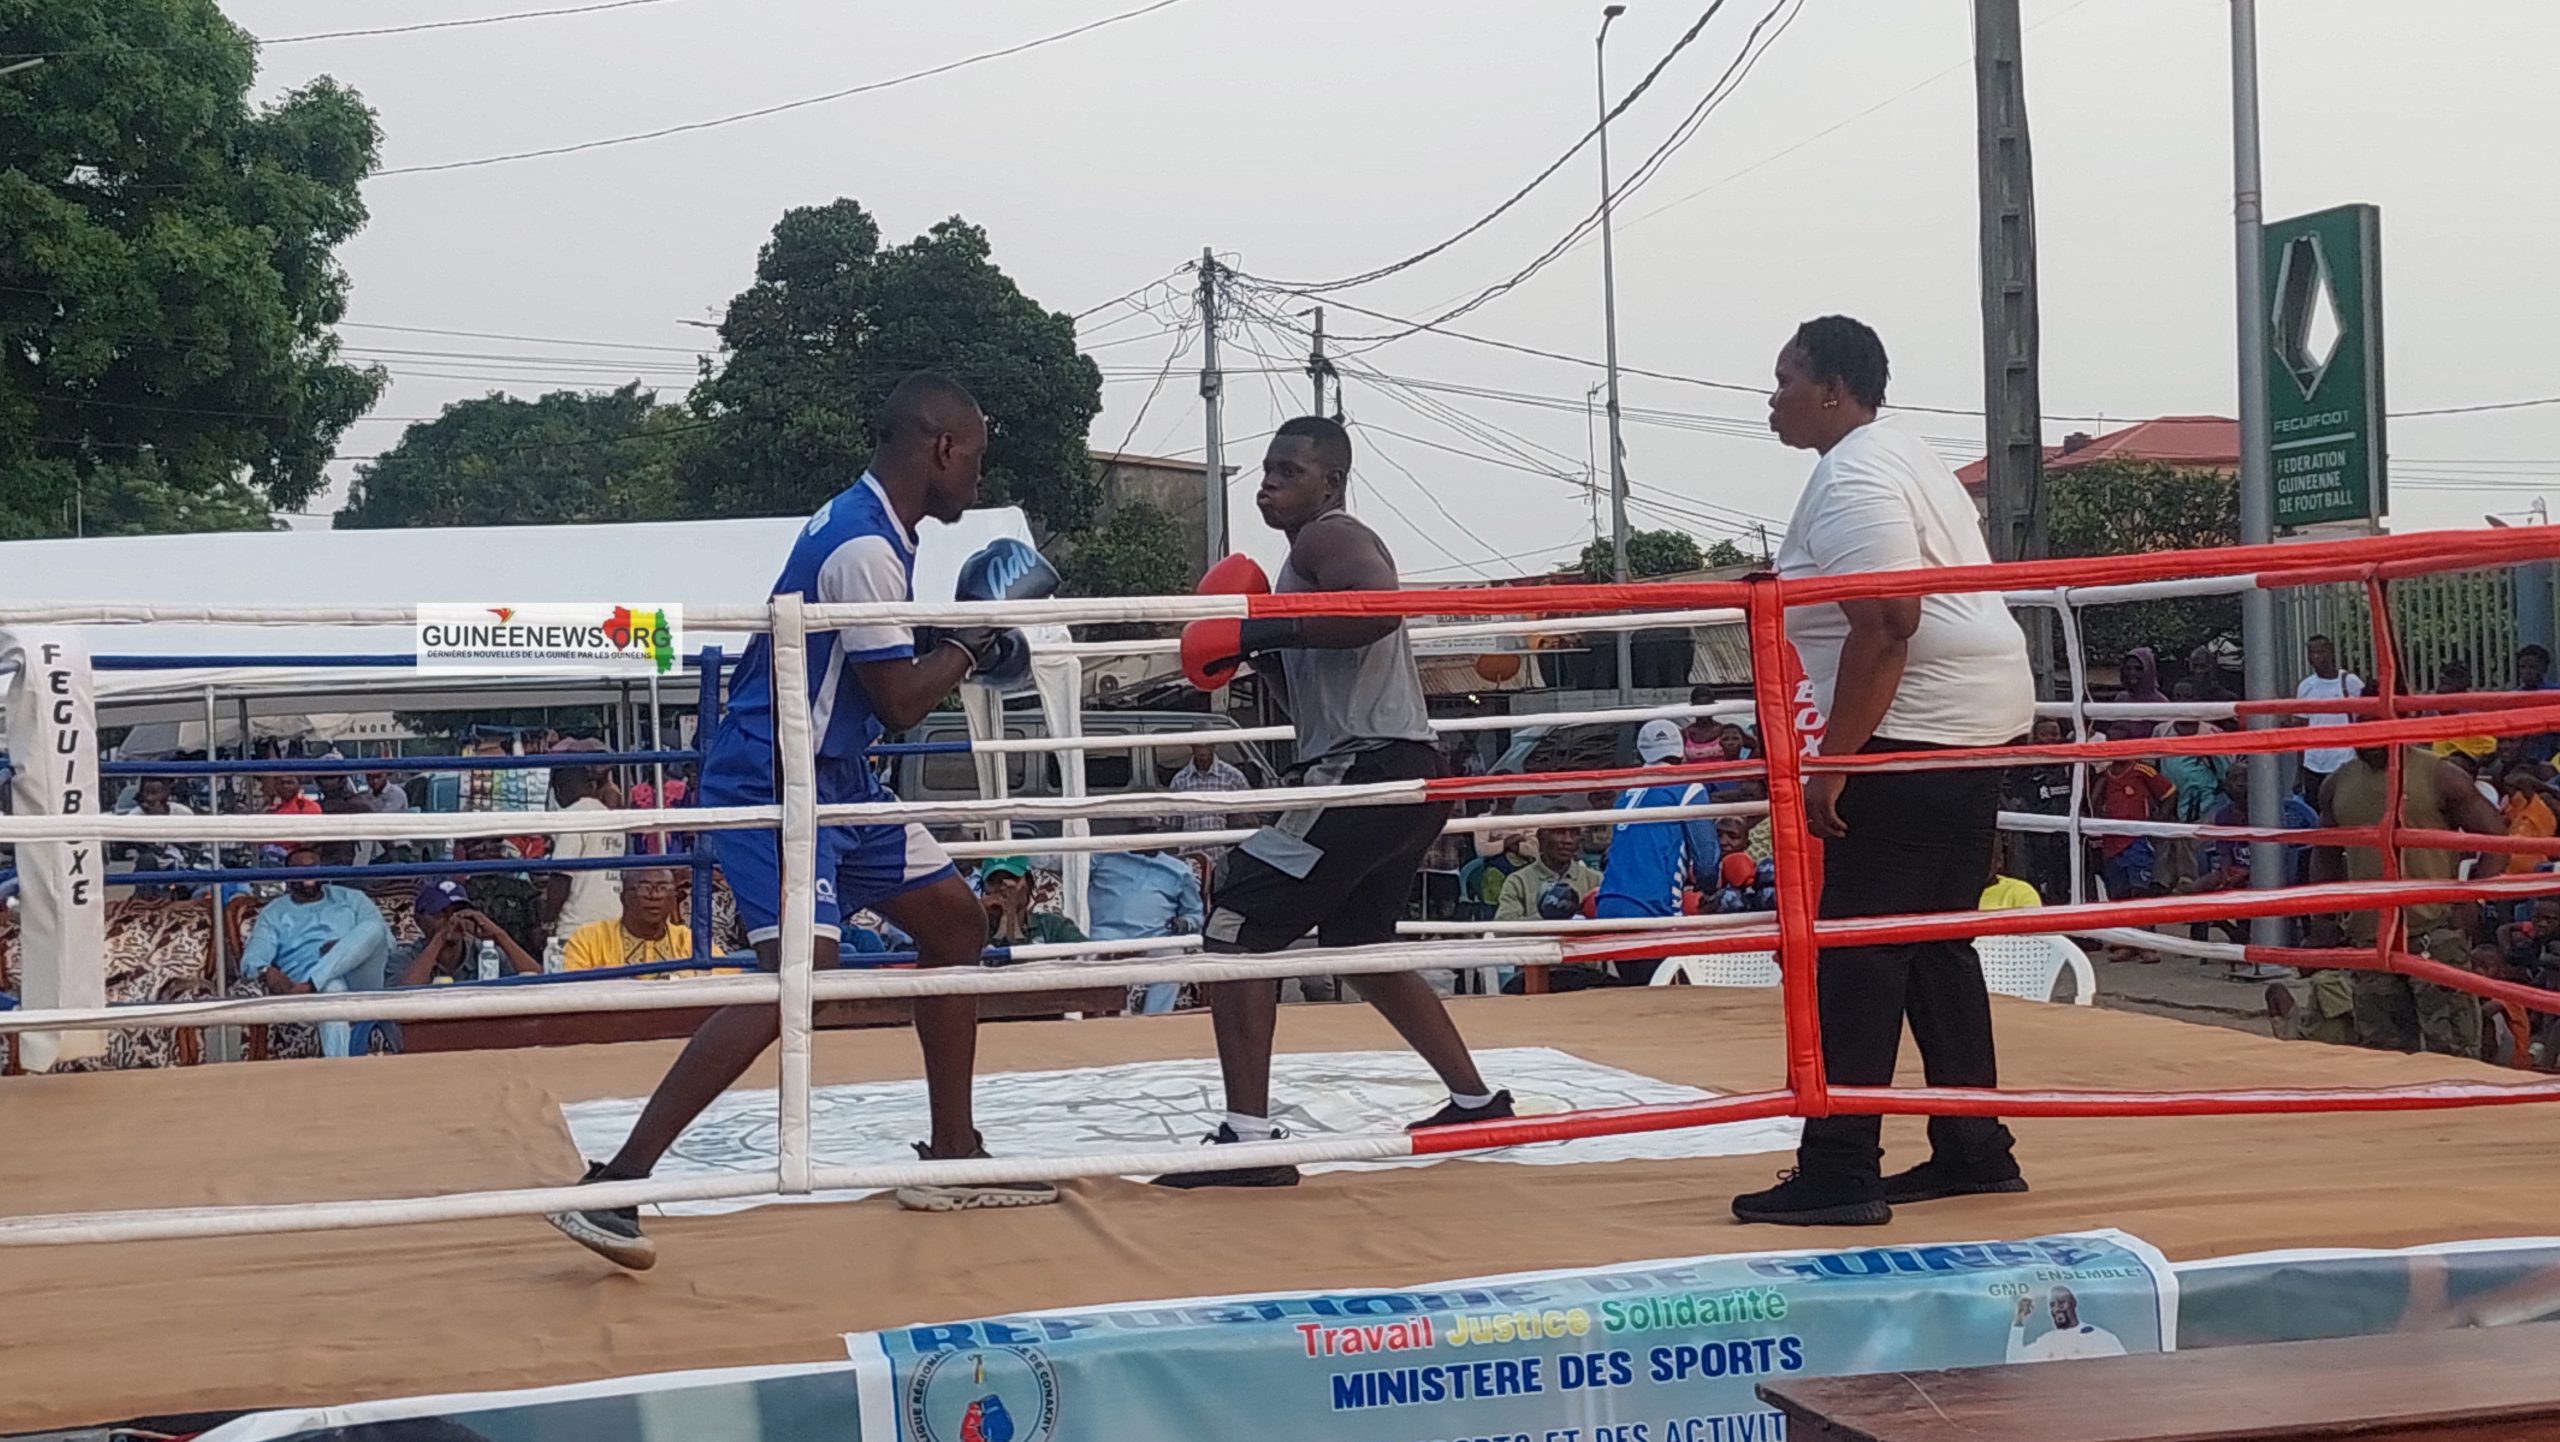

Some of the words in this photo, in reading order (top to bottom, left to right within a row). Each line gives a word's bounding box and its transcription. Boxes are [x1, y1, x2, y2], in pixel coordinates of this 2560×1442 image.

[2277, 449, 2346, 474] FEDERATION
[41, 643, 91, 906] FEGUIBXE
[1988, 1282, 2030, 1296] GMD
[1295, 1316, 1434, 1358] Travail
[1446, 1308, 1591, 1347] Justice
[1601, 1284, 1787, 1333] Solidarité
[1332, 1357, 1544, 1411] MINISTERE
[1558, 1350, 1633, 1391] DES
[1649, 1335, 1804, 1384] SPORTS
[1666, 1411, 1787, 1442] ACTIVIT
